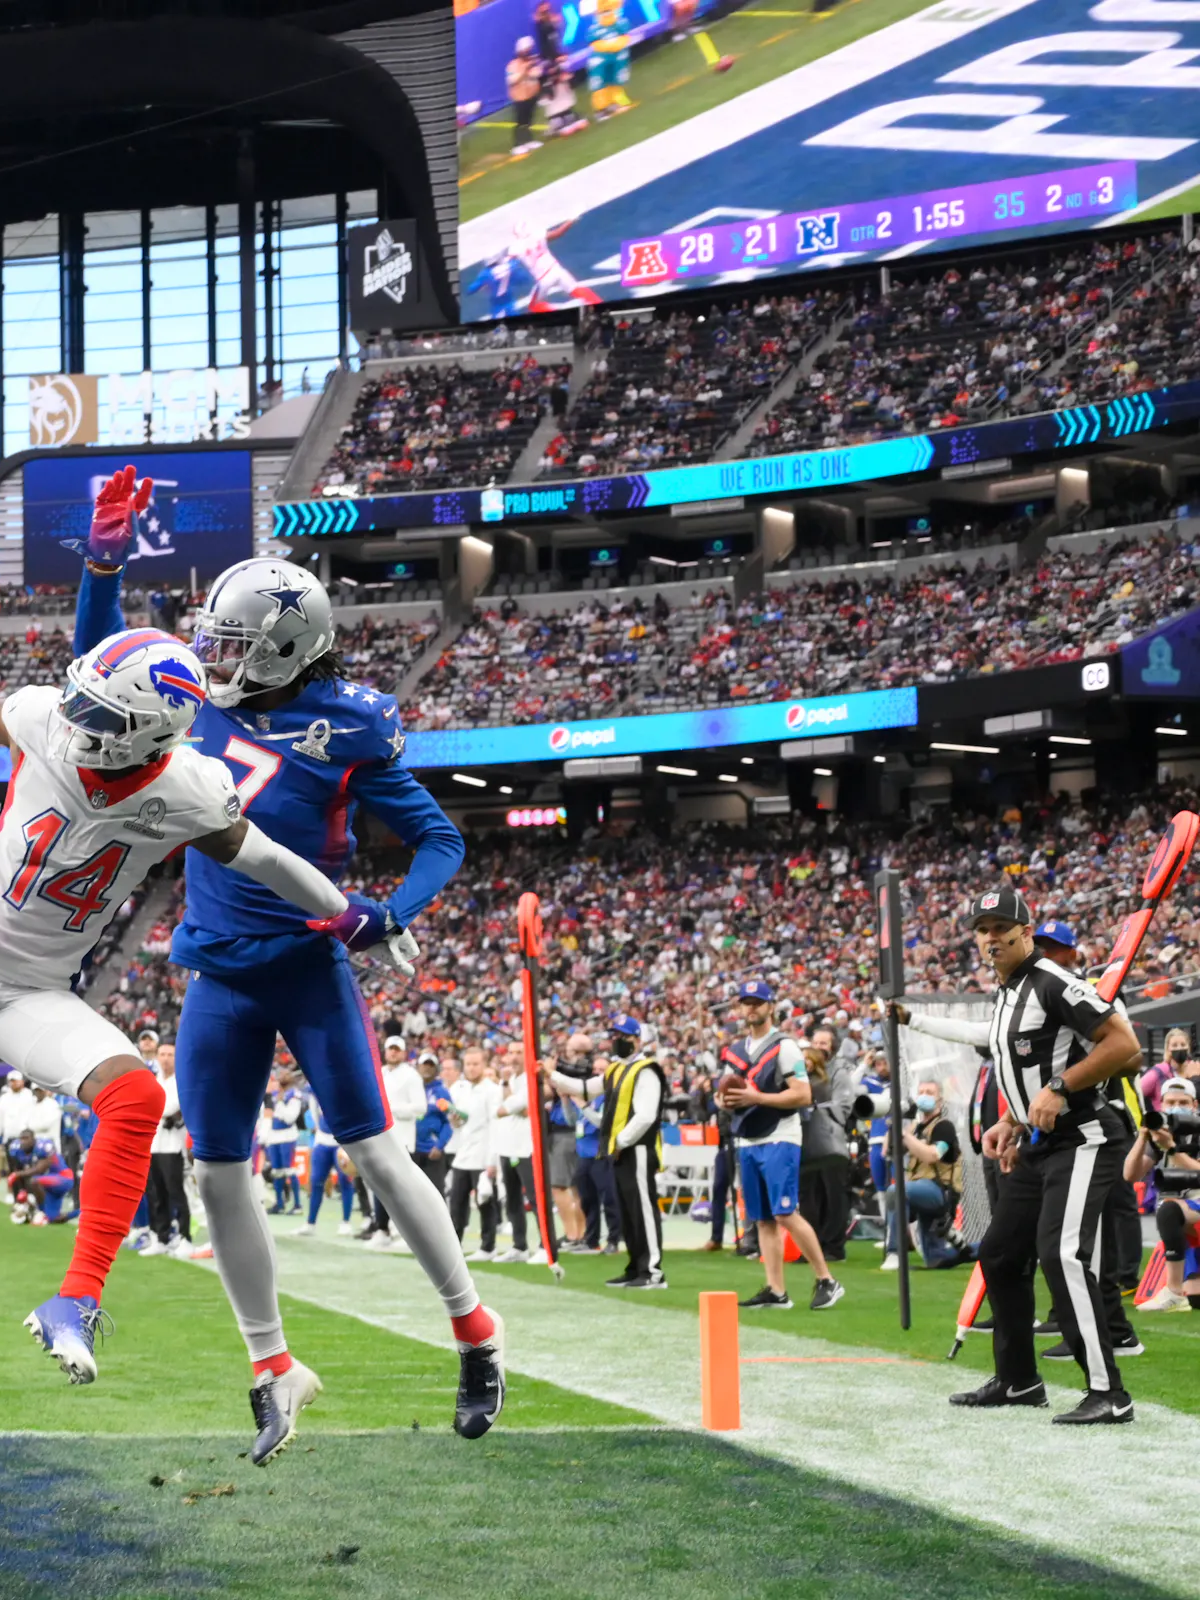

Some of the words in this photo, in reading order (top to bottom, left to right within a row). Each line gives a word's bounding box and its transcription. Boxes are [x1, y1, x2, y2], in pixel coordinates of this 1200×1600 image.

[680, 232, 714, 267] 28
[745, 222, 778, 257] 21
[876, 211, 892, 239] 2
[913, 200, 965, 234] 1:55
[993, 191, 1026, 221] 35
[1045, 184, 1062, 213] 2
[1097, 176, 1114, 205] 3
[108, 366, 251, 414] MGM
[720, 467, 745, 490] WE
[753, 463, 785, 488] RUN
[792, 459, 814, 483] AS
[821, 453, 851, 480] ONE
[505, 493, 530, 515] PRO
[806, 704, 848, 726] pepsi
[571, 726, 616, 749] pepsi
[222, 735, 283, 813] 7
[2, 807, 132, 933] 14
